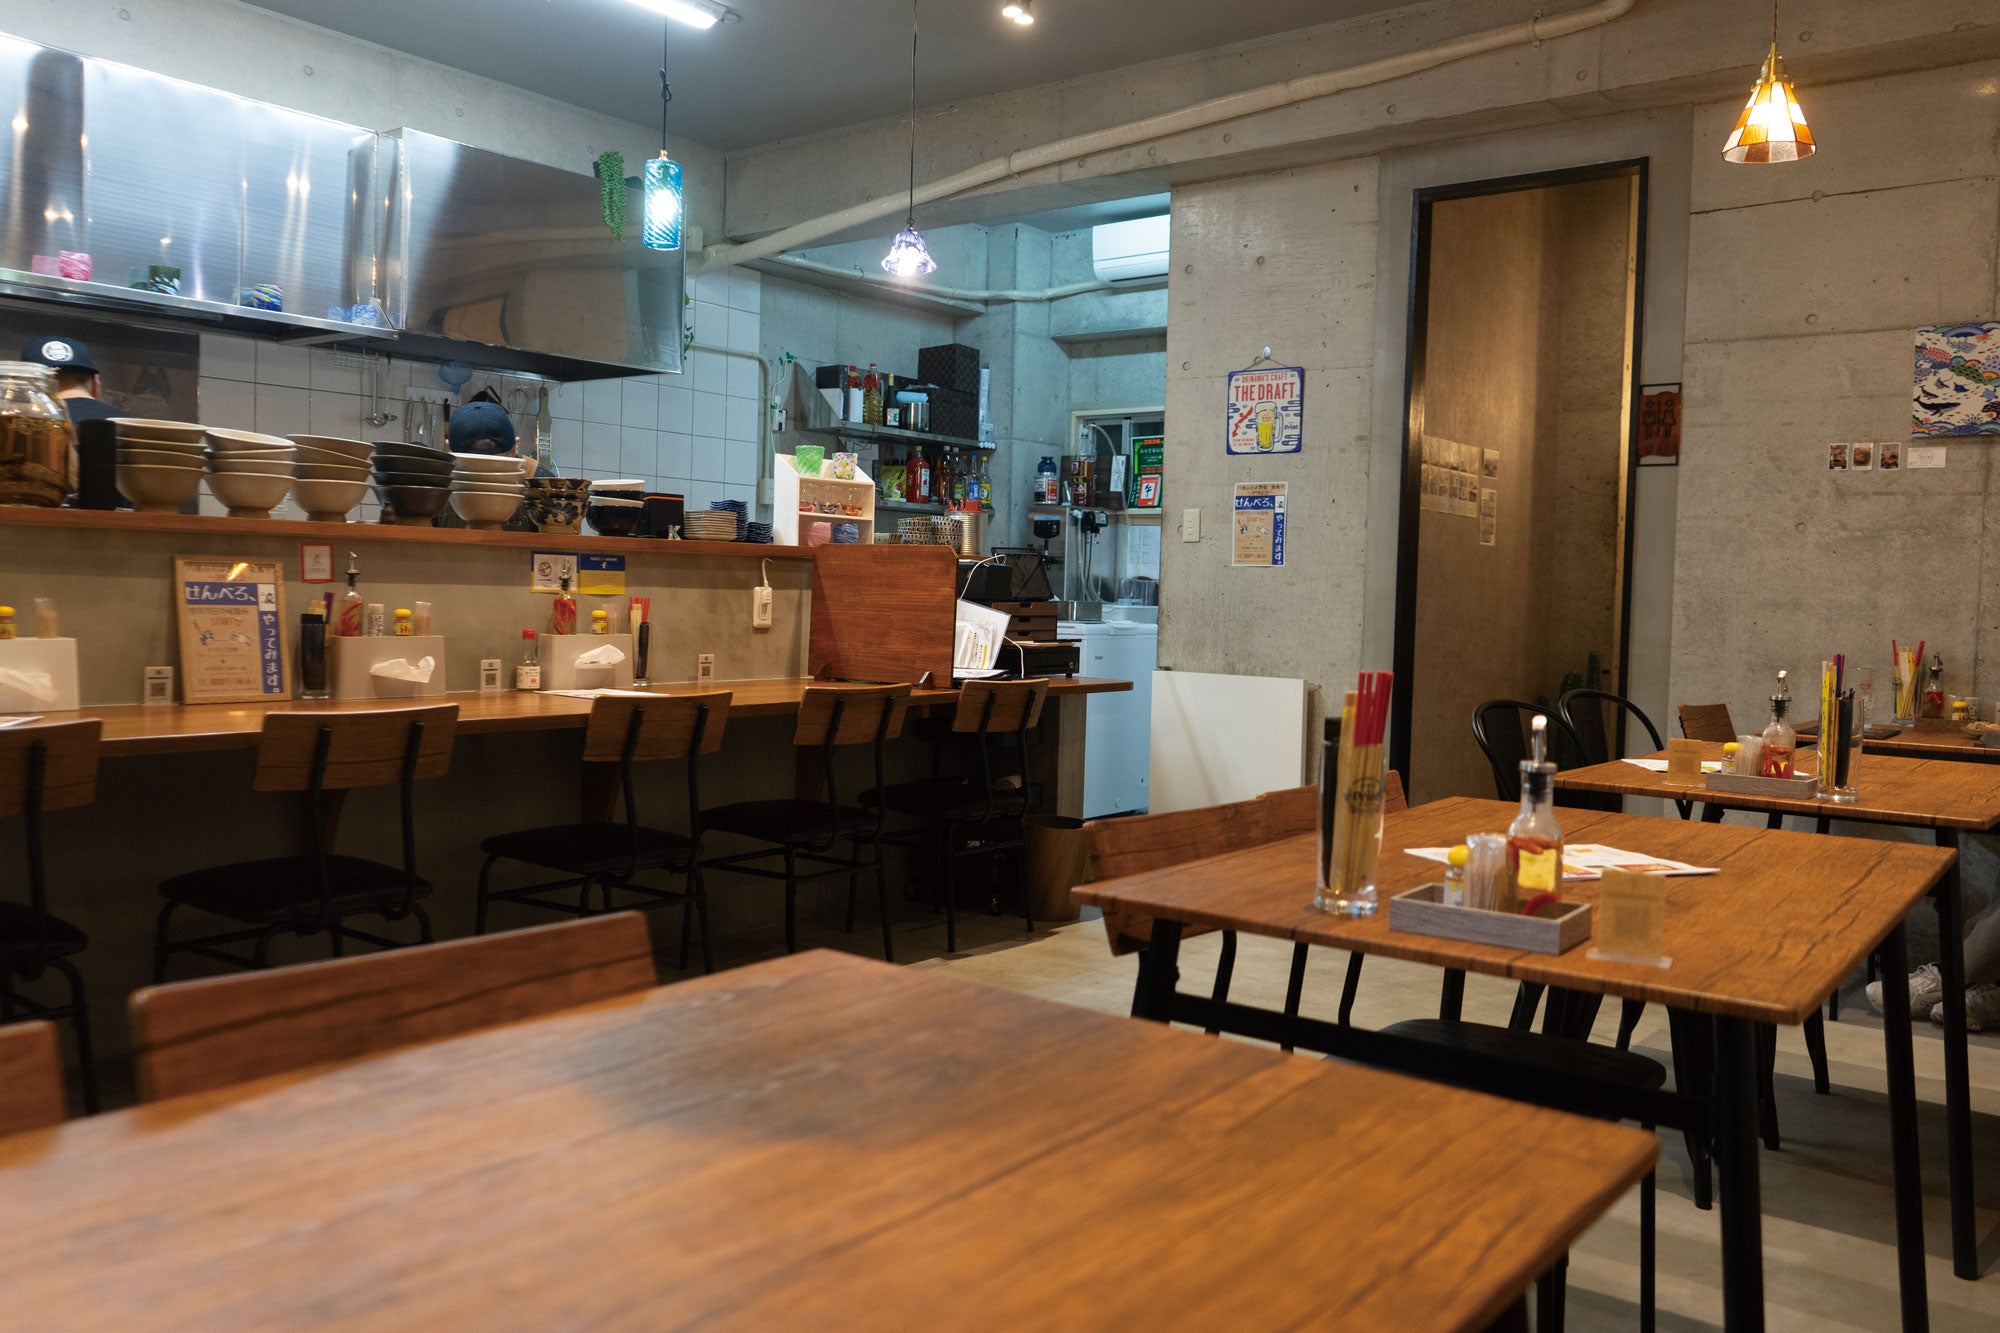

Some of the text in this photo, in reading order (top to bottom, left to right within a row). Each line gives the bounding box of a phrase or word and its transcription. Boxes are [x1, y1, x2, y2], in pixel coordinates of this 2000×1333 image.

[1270, 372, 1288, 382] CRAFT
[1234, 382, 1296, 402] THE DRAFT
[262, 613, 281, 693] やってみます。
